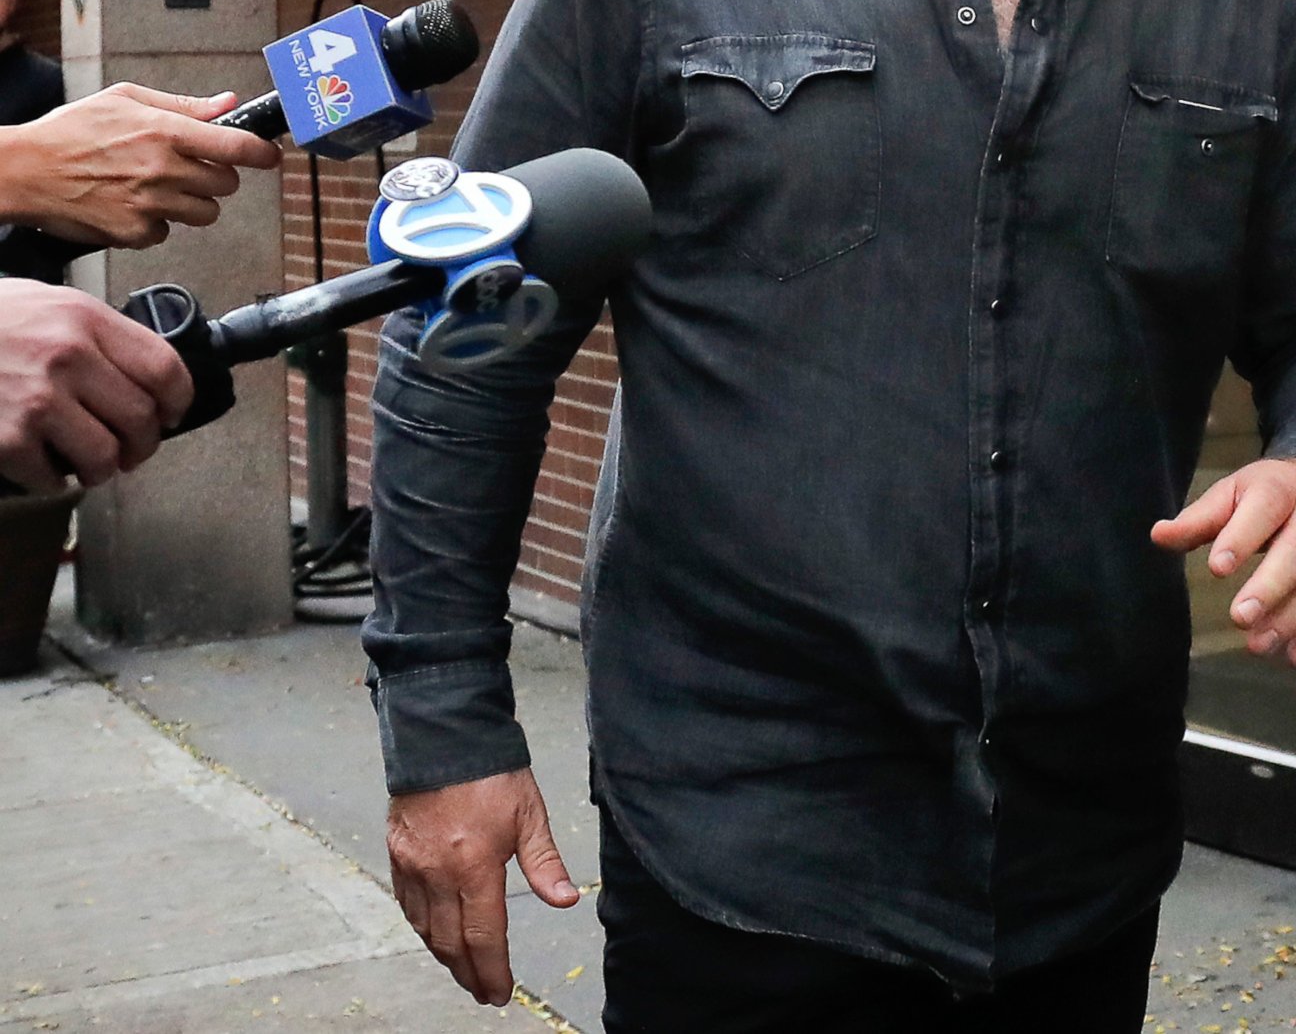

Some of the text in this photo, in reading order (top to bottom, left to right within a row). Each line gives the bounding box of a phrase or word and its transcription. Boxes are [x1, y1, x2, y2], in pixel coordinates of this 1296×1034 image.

[288, 39, 329, 131] NEW YORK
[307, 28, 358, 75] 4
